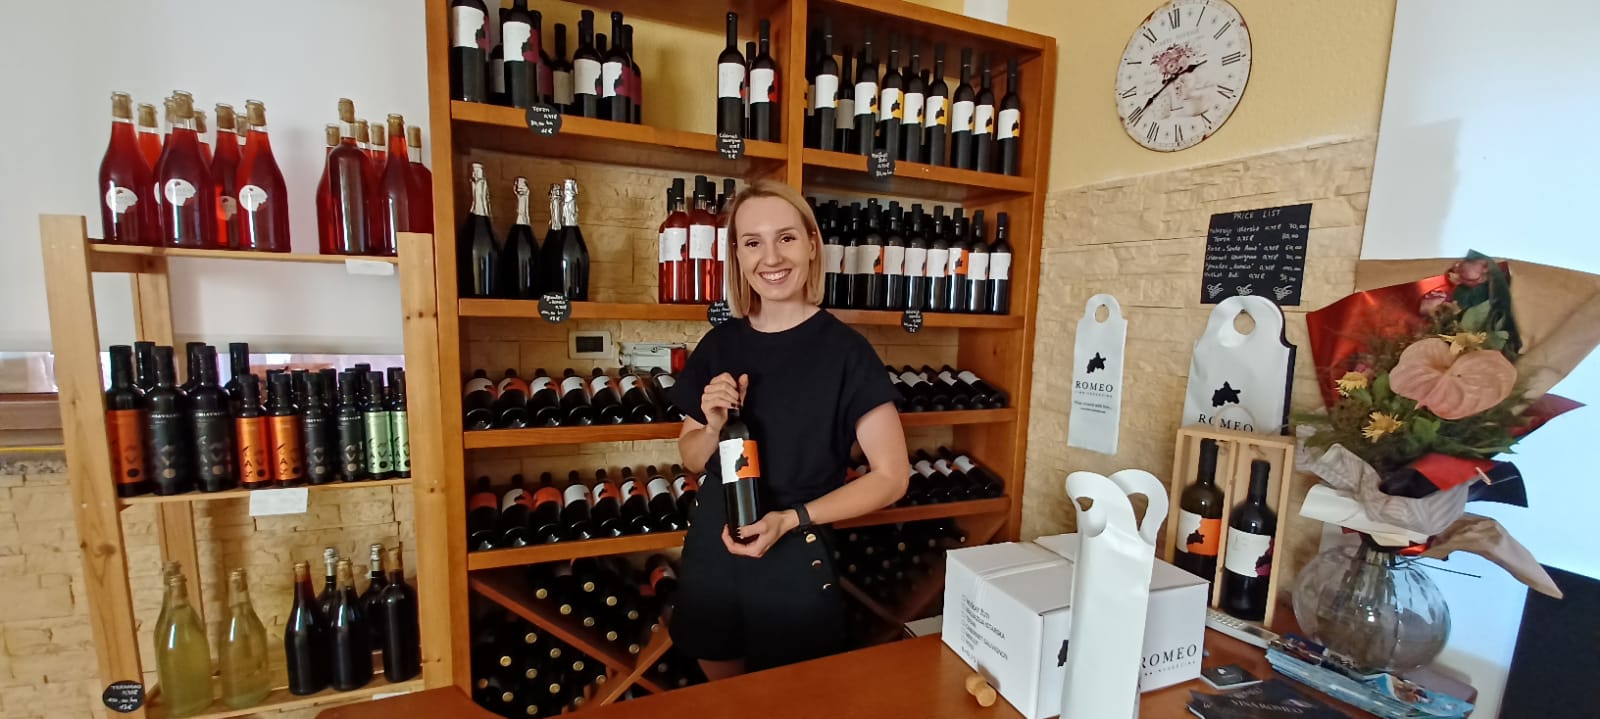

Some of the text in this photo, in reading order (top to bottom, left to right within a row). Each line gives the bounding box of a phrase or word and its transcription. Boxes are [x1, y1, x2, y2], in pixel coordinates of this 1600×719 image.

[1221, 51, 1241, 66] III
[1233, 208, 1281, 221] PRICE LIST
[1075, 380, 1114, 393] ROMEO
